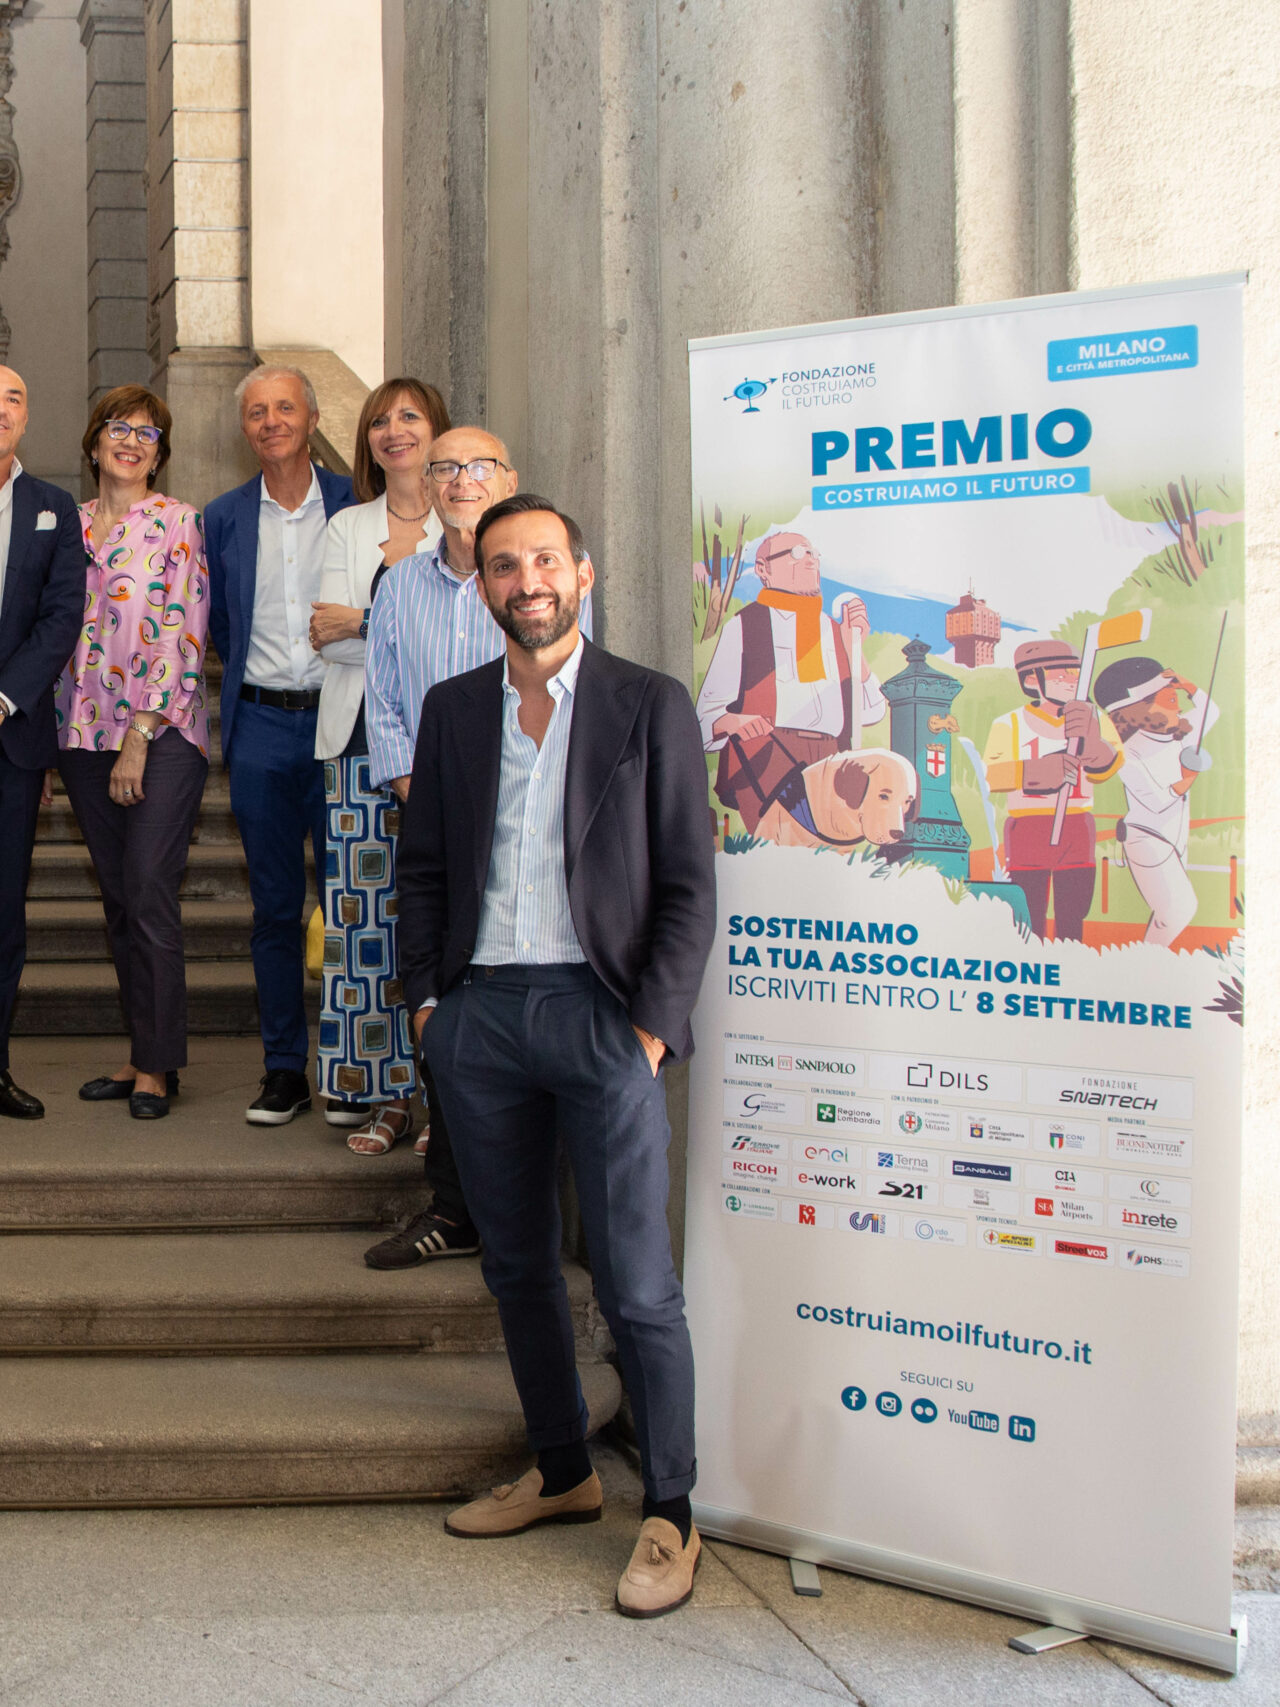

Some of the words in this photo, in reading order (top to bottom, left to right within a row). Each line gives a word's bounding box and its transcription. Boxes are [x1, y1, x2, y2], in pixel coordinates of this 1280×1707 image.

[1078, 336, 1167, 360] MILANO
[1056, 365, 1063, 373] E
[1066, 360, 1095, 372] CITTÀ
[1098, 352, 1190, 370] METROPOLITANA
[782, 362, 876, 383] FONDAZIONE
[782, 377, 877, 396] COSTRUIAMO
[782, 398, 793, 410] IL
[796, 392, 853, 409] FUTURO
[811, 407, 1093, 476] PREMIO
[824, 481, 958, 505] COSTRUIAMO
[966, 480, 982, 496] IL
[991, 473, 1076, 494] FUTURO
[728, 915, 919, 946] SOSTENIAMO
[728, 945, 762, 967] LA
[767, 947, 823, 972] TUA
[829, 950, 1061, 987] ASSOCIAZIONE
[728, 975, 836, 1004] ISCRIVITI
[846, 983, 939, 1011] ENTRO
[976, 992, 994, 1014] 8
[1003, 993, 1192, 1029] SETTEMBRE
[735, 1053, 774, 1067] INTESA
[940, 1071, 989, 1091] DILS
[1081, 1077, 1138, 1091] FONDAZIONE
[837, 1107, 871, 1118] Regione
[837, 1114, 881, 1125] Lombardia
[1066, 1133, 1085, 1142] CONI
[804, 1146, 849, 1163] enel
[895, 1154, 929, 1168] Terna
[733, 1161, 777, 1175] RICOH
[1055, 1170, 1076, 1182] CIA
[798, 1172, 856, 1189] e-work
[1061, 1201, 1084, 1211] Milan
[1061, 1209, 1093, 1220] Airports
[1122, 1208, 1178, 1229] inrete
[1144, 1255, 1162, 1265] DHS
[796, 1302, 1092, 1365] costruiamoilfuturo.it
[900, 1371, 953, 1390] SEGUICI
[957, 1380, 974, 1393] SU
